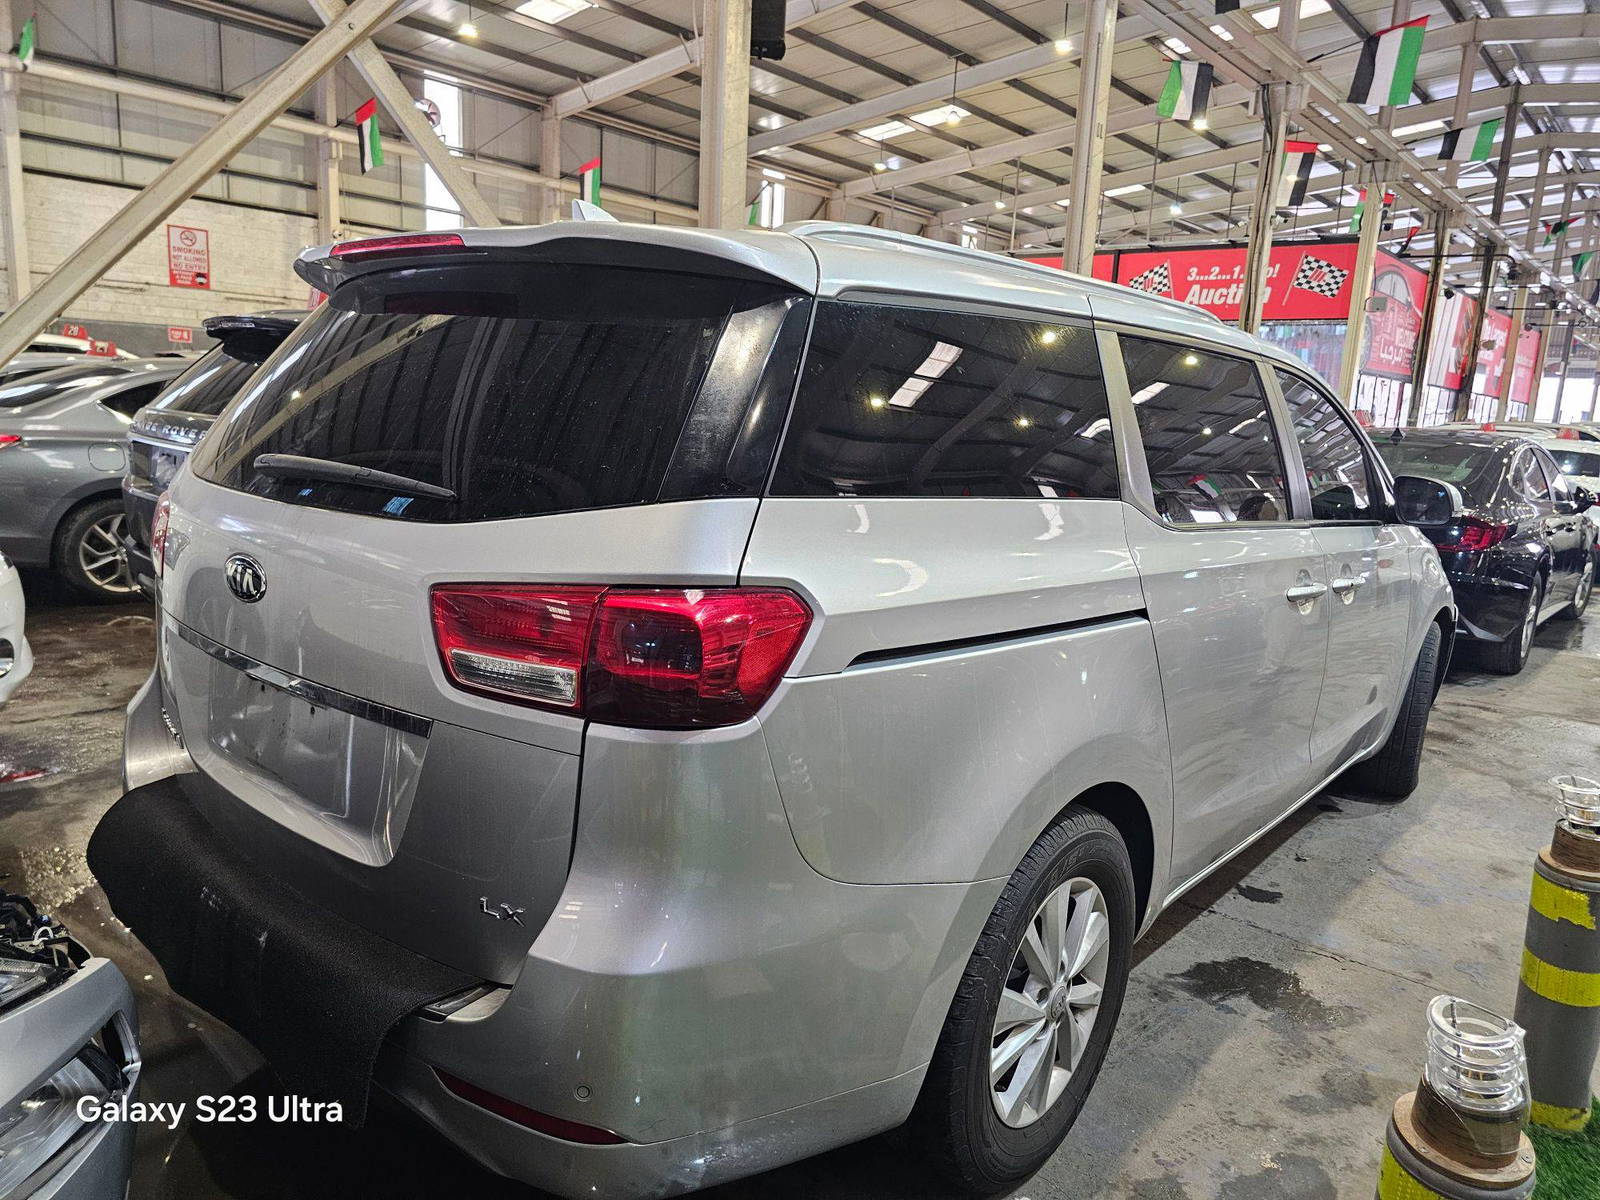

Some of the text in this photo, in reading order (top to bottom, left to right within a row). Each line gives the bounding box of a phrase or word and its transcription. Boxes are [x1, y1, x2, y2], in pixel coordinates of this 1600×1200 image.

[173, 246, 206, 255] SMOKING
[1184, 283, 1272, 305] Auctin
[479, 896, 525, 927] LX
